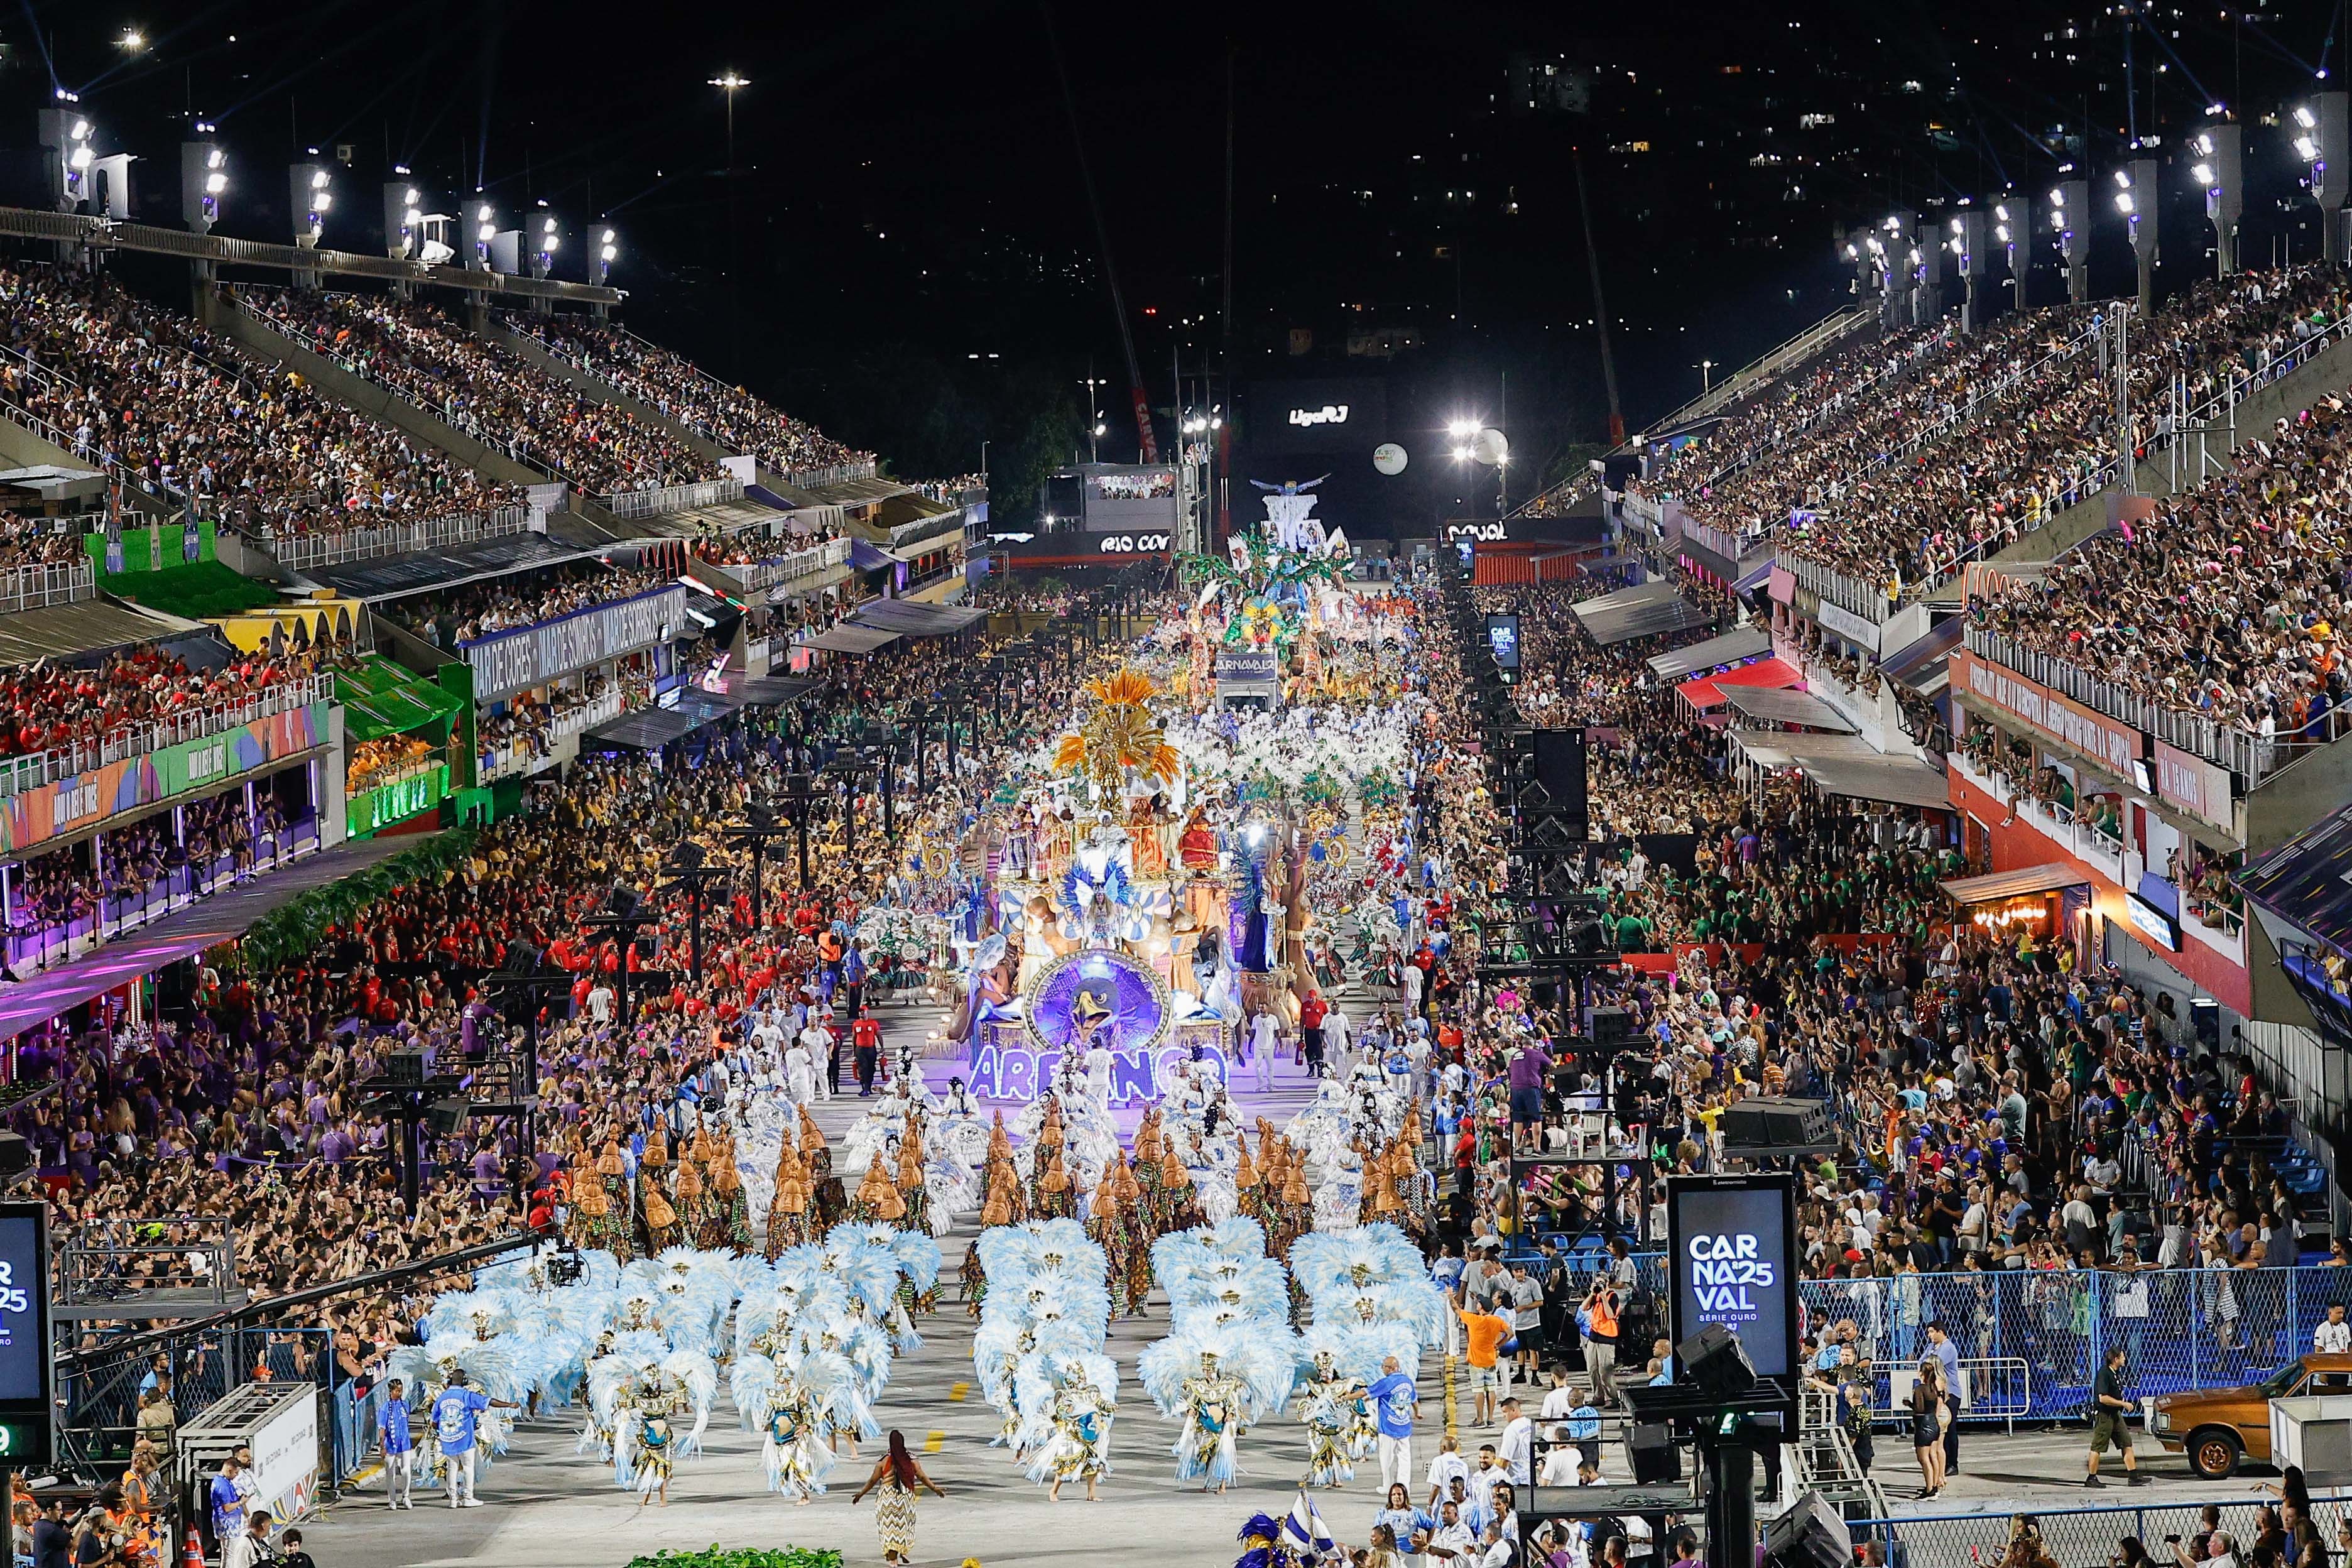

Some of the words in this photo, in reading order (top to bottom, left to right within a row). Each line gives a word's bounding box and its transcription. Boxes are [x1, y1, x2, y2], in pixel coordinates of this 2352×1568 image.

[1289, 405, 1349, 427] LigaRJ
[1101, 536, 1133, 553] RIO
[1491, 627, 1511, 635] CAR
[470, 645, 491, 699] MAR
[492, 642, 504, 692] DE
[504, 633, 531, 688] CORES
[538, 628, 558, 678] MAR
[557, 623, 568, 671] DE
[567, 615, 596, 668] SONHOS
[602, 608, 621, 655] MAR
[628, 598, 658, 646] SORRISOS
[2160, 748, 2170, 792] HÁ
[2180, 767, 2197, 805] ANOS
[967, 1043, 1230, 1102] ARNCO
[1689, 1234, 1758, 1261] CAR
[1693, 1286, 1756, 1311] VAL
[1699, 1314, 1727, 1322] SÉRIE
